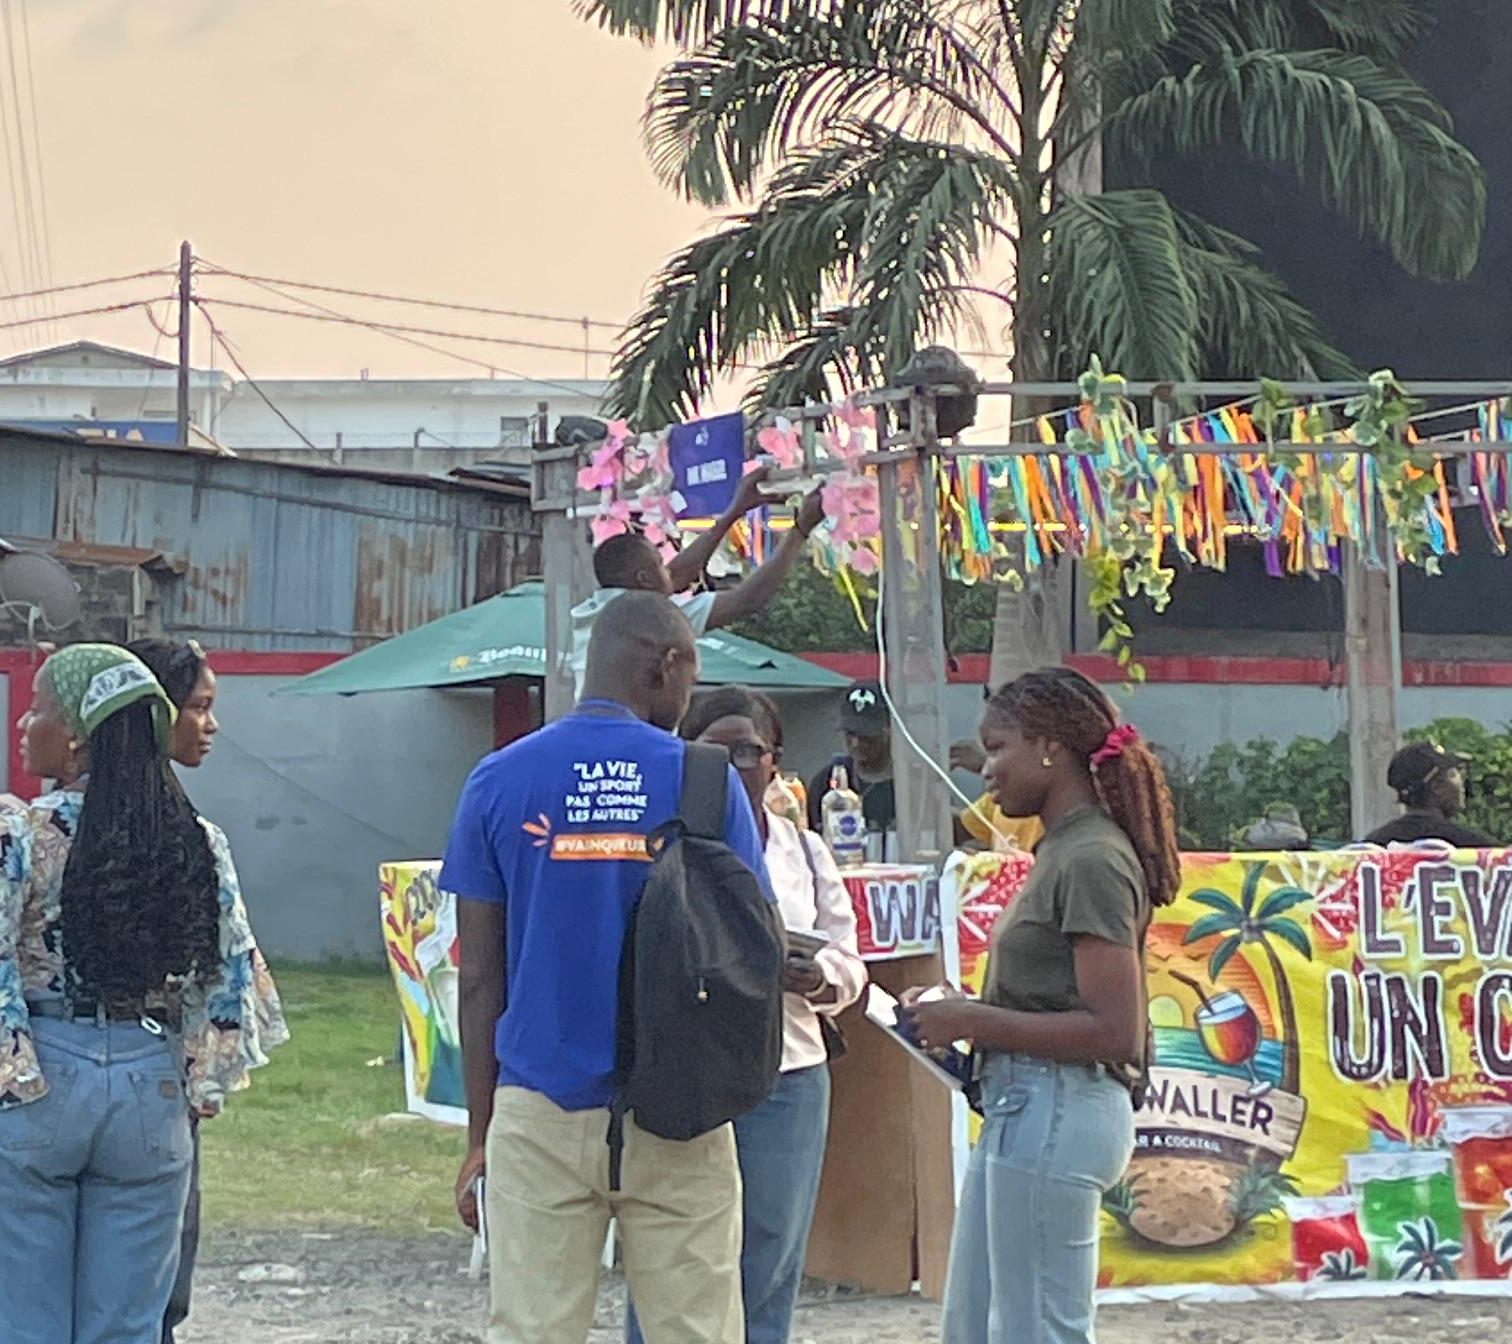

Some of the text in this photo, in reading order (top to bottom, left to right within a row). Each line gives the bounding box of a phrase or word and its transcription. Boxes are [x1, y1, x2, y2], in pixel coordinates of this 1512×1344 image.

[577, 778, 643, 793] UN SPORT
[565, 793, 648, 808] PAS COMME
[567, 808, 590, 823] LES
[1359, 862, 1512, 957] L'EV
[1329, 971, 1448, 1081] UN
